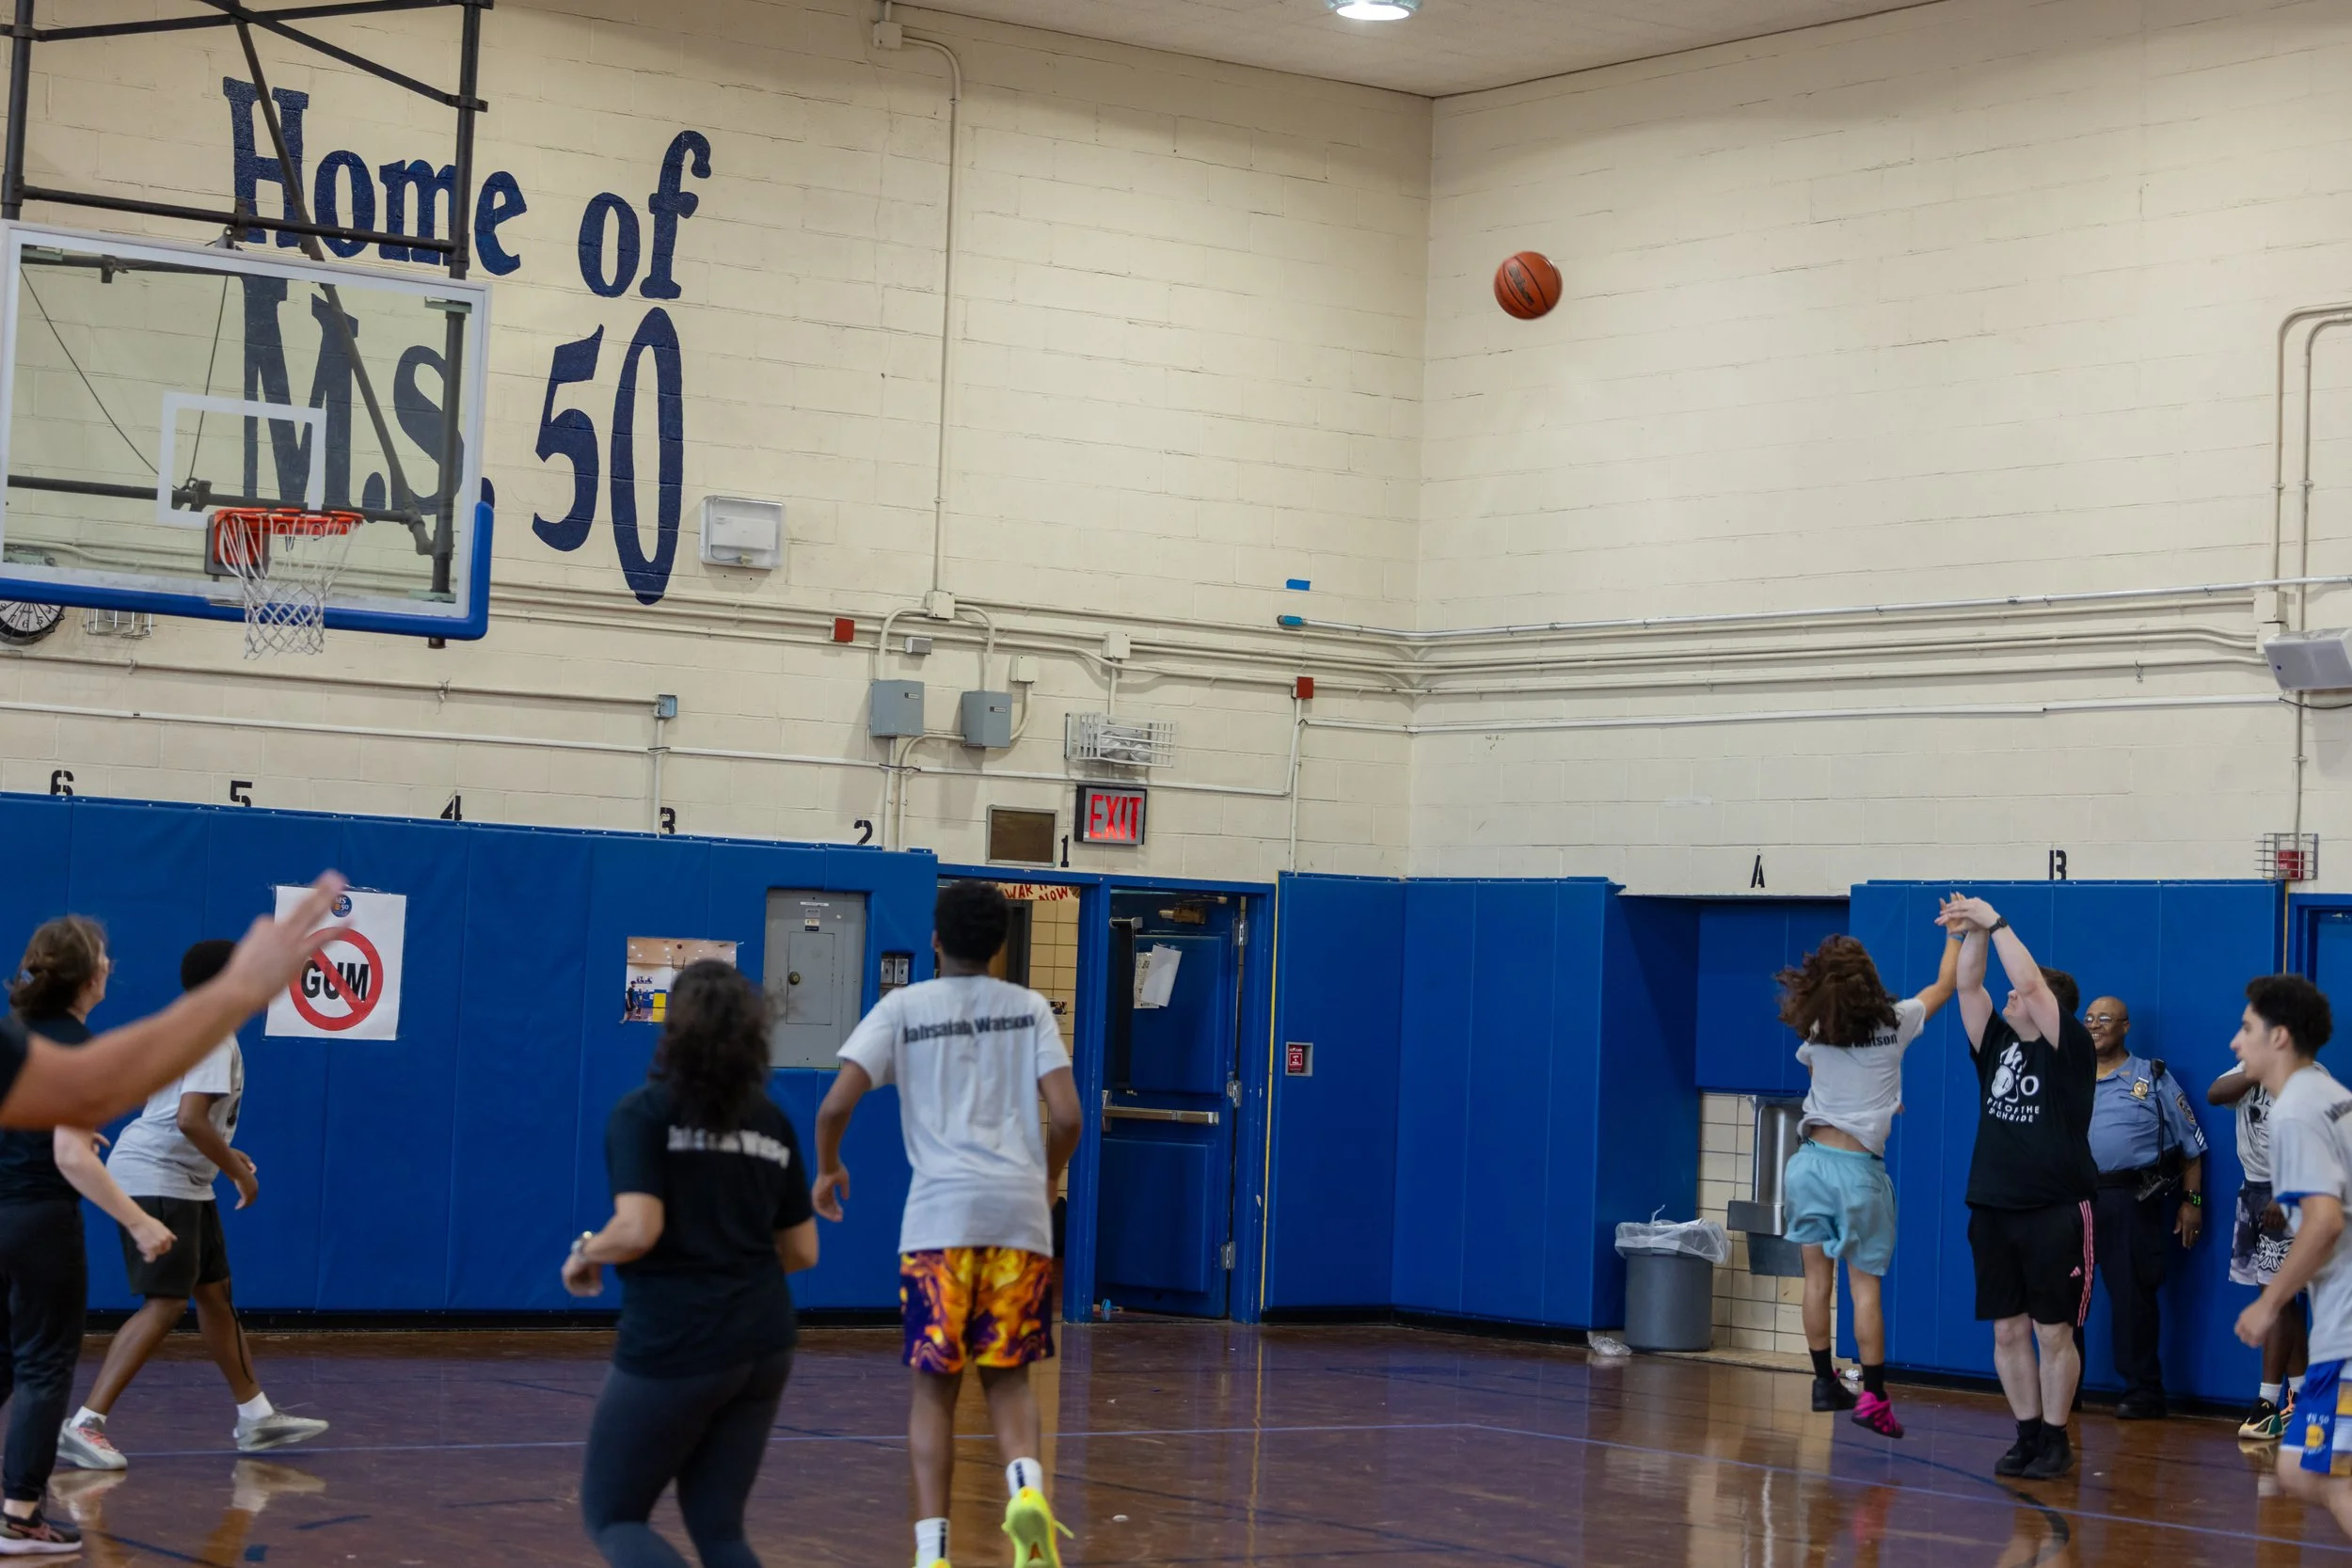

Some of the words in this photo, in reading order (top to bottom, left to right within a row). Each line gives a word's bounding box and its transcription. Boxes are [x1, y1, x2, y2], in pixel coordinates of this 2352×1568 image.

[223, 77, 527, 276] Home
[579, 130, 711, 299] of
[532, 307, 684, 605] 50
[51, 769, 74, 796] 6
[230, 780, 252, 807] 5
[440, 795, 462, 820] 4
[660, 807, 675, 834] 3
[1089, 794, 1142, 841] EXIT
[854, 819, 873, 845] 2
[1060, 834, 1069, 867] 1
[2049, 849, 2066, 880] B
[1750, 854, 1765, 888] A
[1005, 884, 1033, 898] WAR
[301, 959, 369, 1001] GUM
[1854, 1034, 1898, 1048] tson
